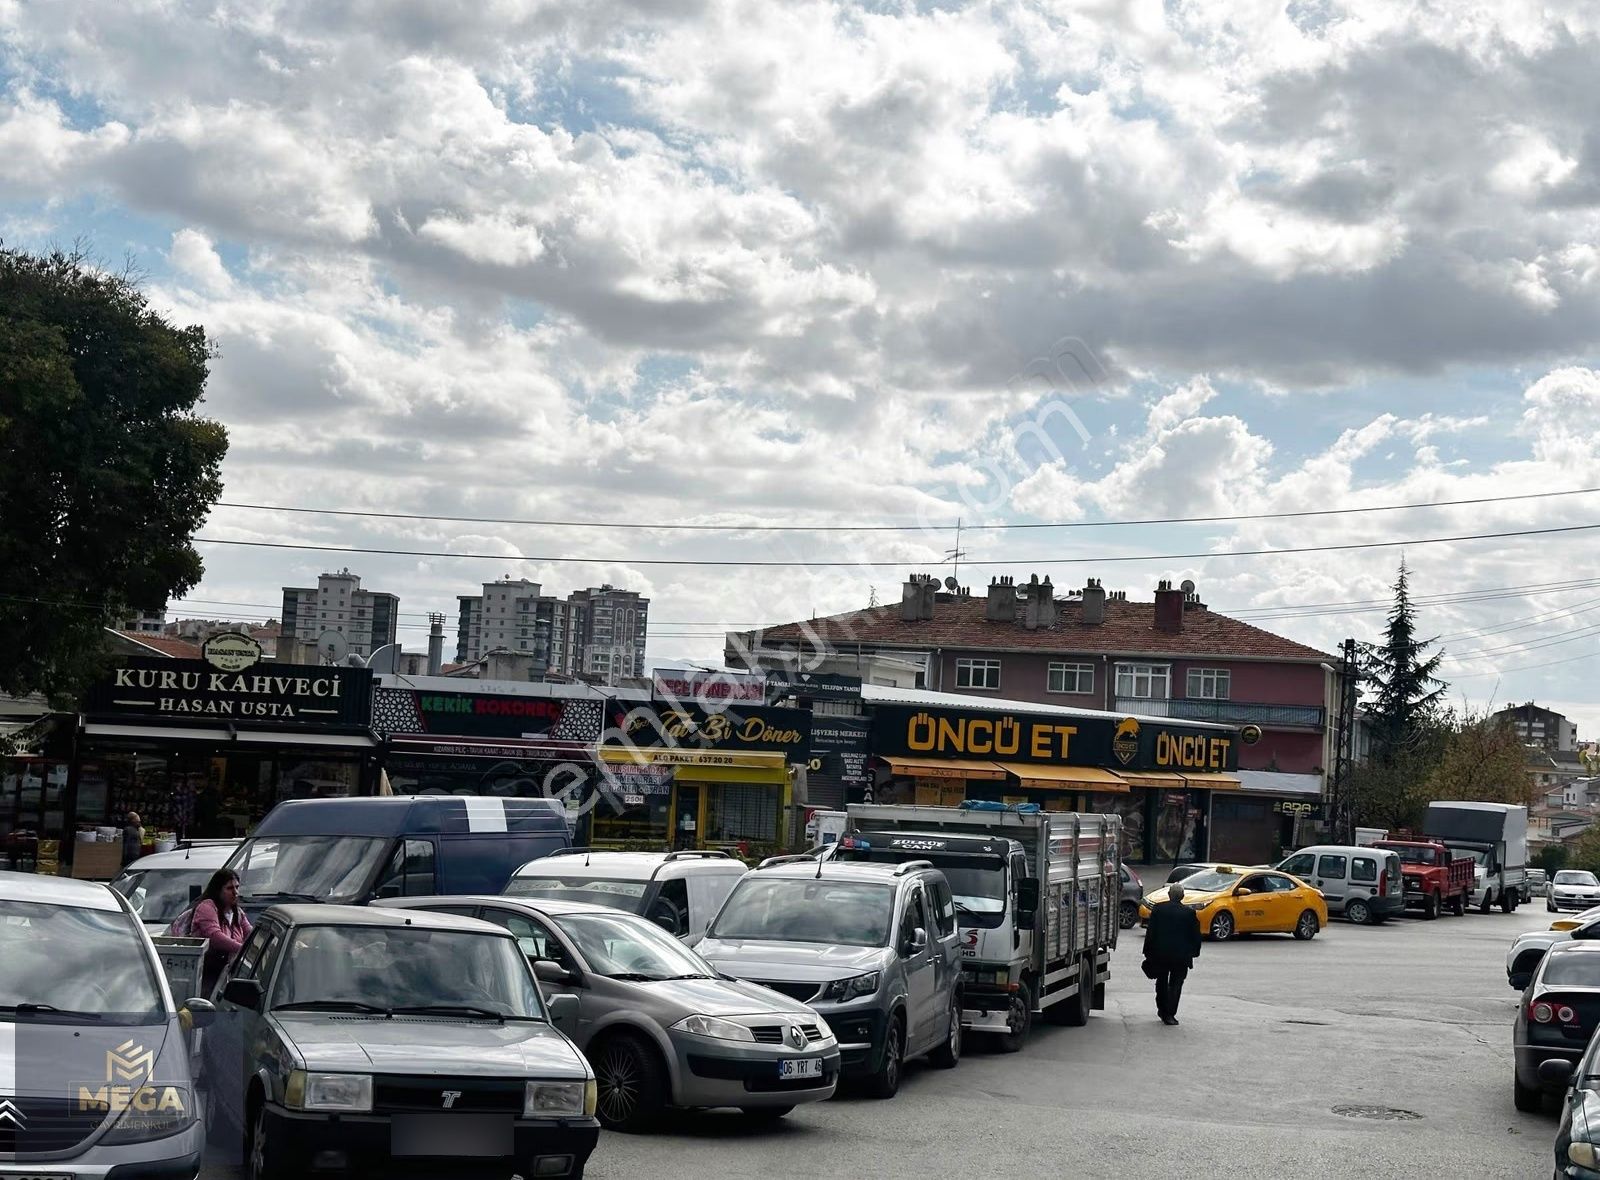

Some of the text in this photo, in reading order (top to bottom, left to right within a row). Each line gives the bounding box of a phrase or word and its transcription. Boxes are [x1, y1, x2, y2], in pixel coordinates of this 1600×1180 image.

[114, 668, 342, 698] KURU KAHVECİ
[821, 684, 843, 692] TELEFON
[159, 698, 296, 718] HASAN USTA
[421, 694, 473, 713] KEKİK
[736, 716, 803, 743] Döner
[907, 712, 1078, 759] ÖNCÜ ET
[653, 754, 668, 762] ALO
[670, 755, 694, 763] PAKET
[698, 756, 712, 764] 637
[724, 757, 733, 765] 20
[1156, 730, 1231, 769] ÖNCÜ ET
[783, 1060, 793, 1074] 06
[797, 1060, 809, 1074] YRT
